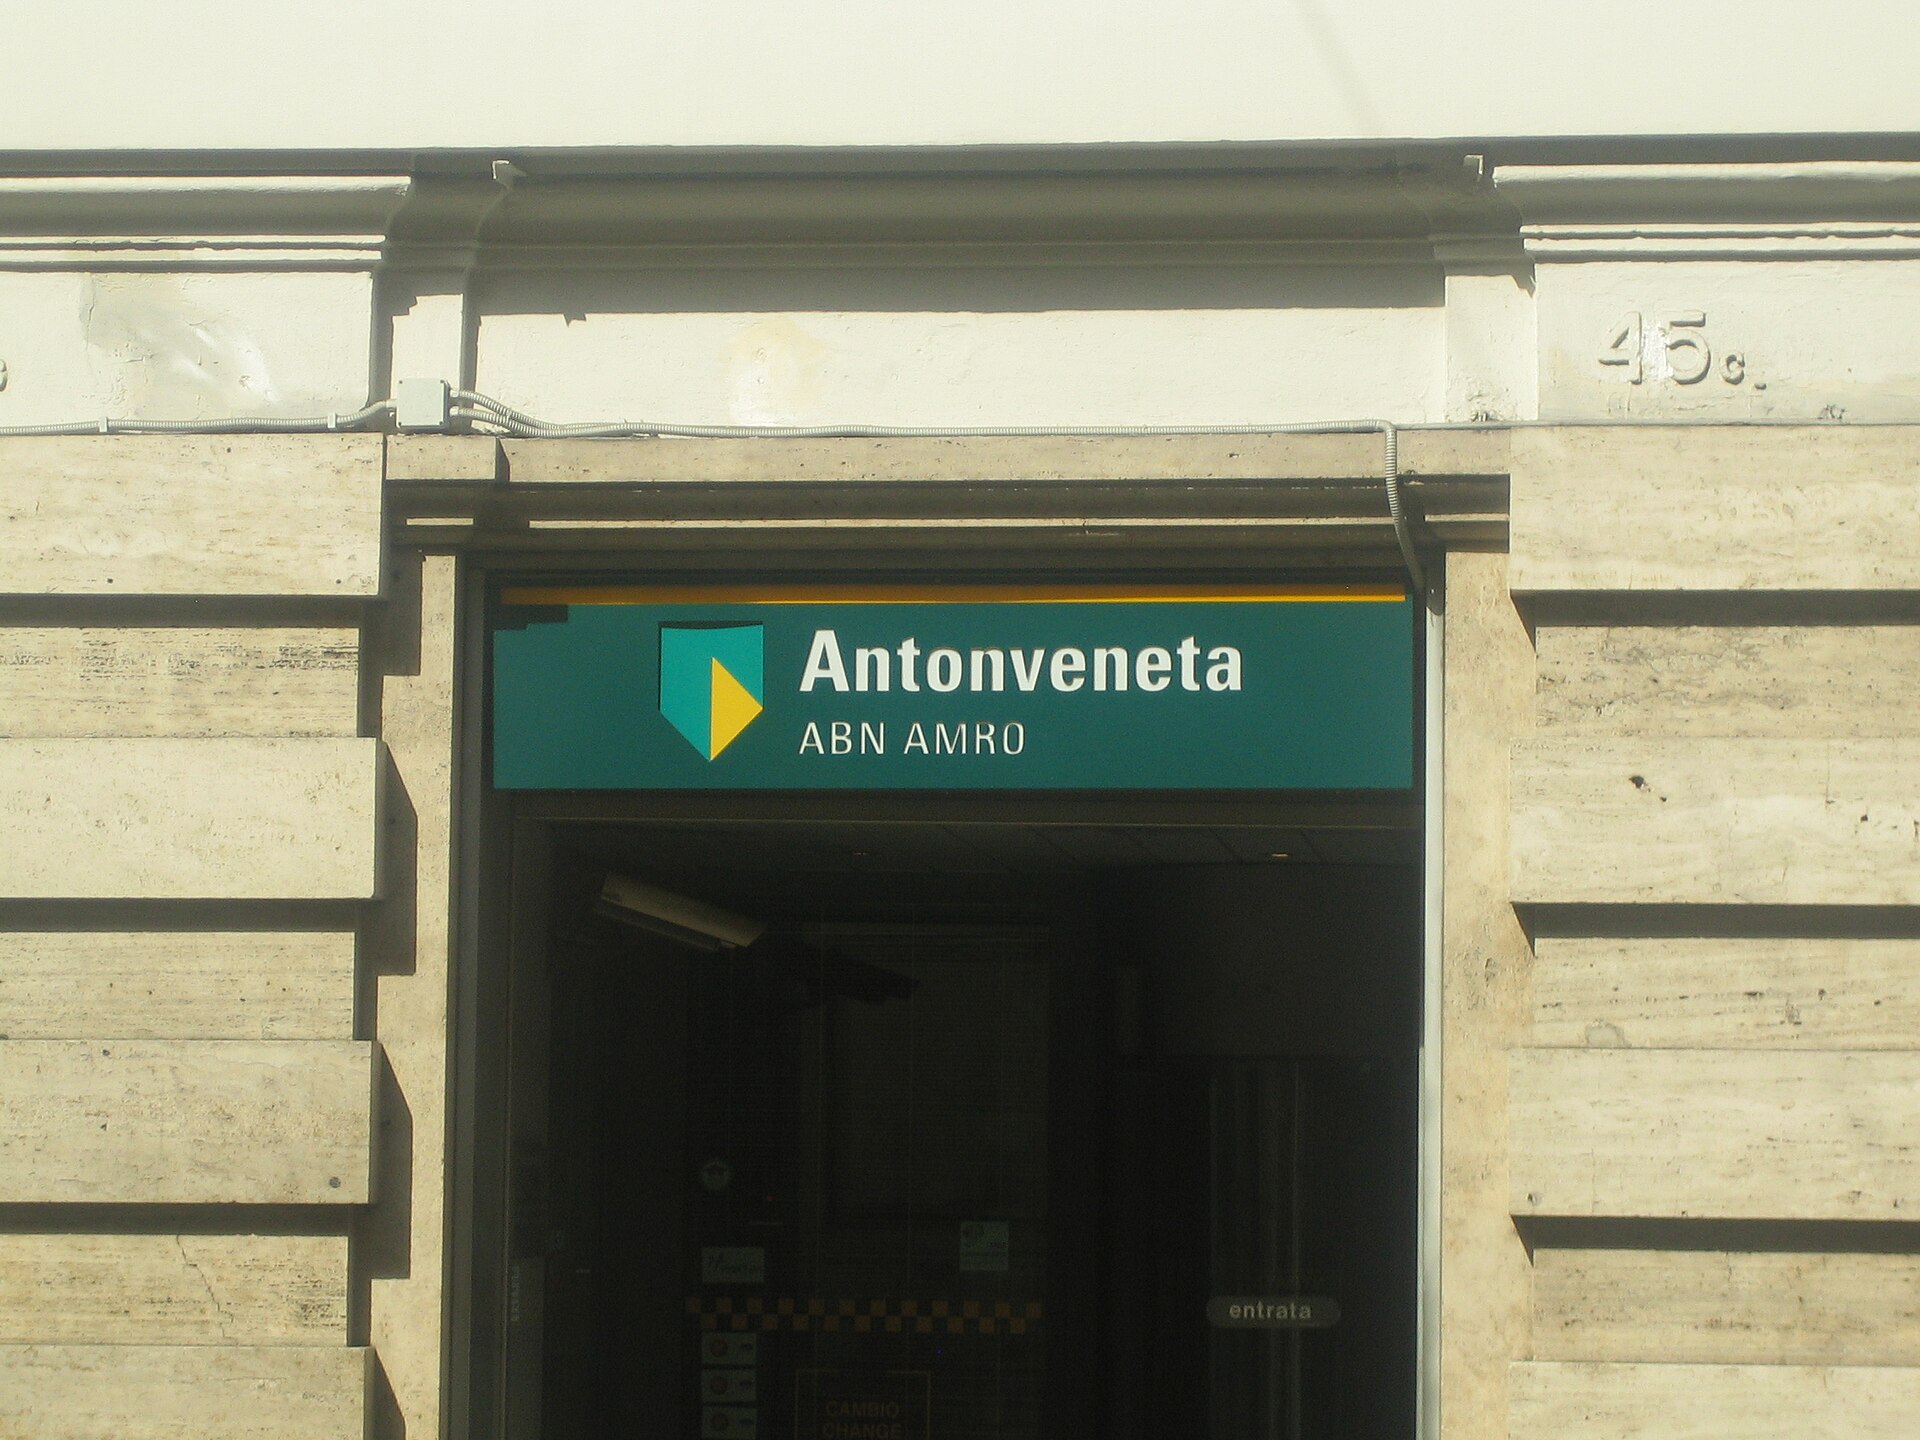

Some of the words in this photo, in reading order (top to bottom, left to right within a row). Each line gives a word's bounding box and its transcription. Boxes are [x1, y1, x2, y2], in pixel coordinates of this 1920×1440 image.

[800, 629, 1243, 693] Antonveneta
[799, 721, 886, 755] ABN
[903, 721, 1026, 755] AMRO
[1228, 1299, 1313, 1321] entrata
[825, 1400, 900, 1418] CAMBIO
[822, 1422, 903, 1440] CHANGE
